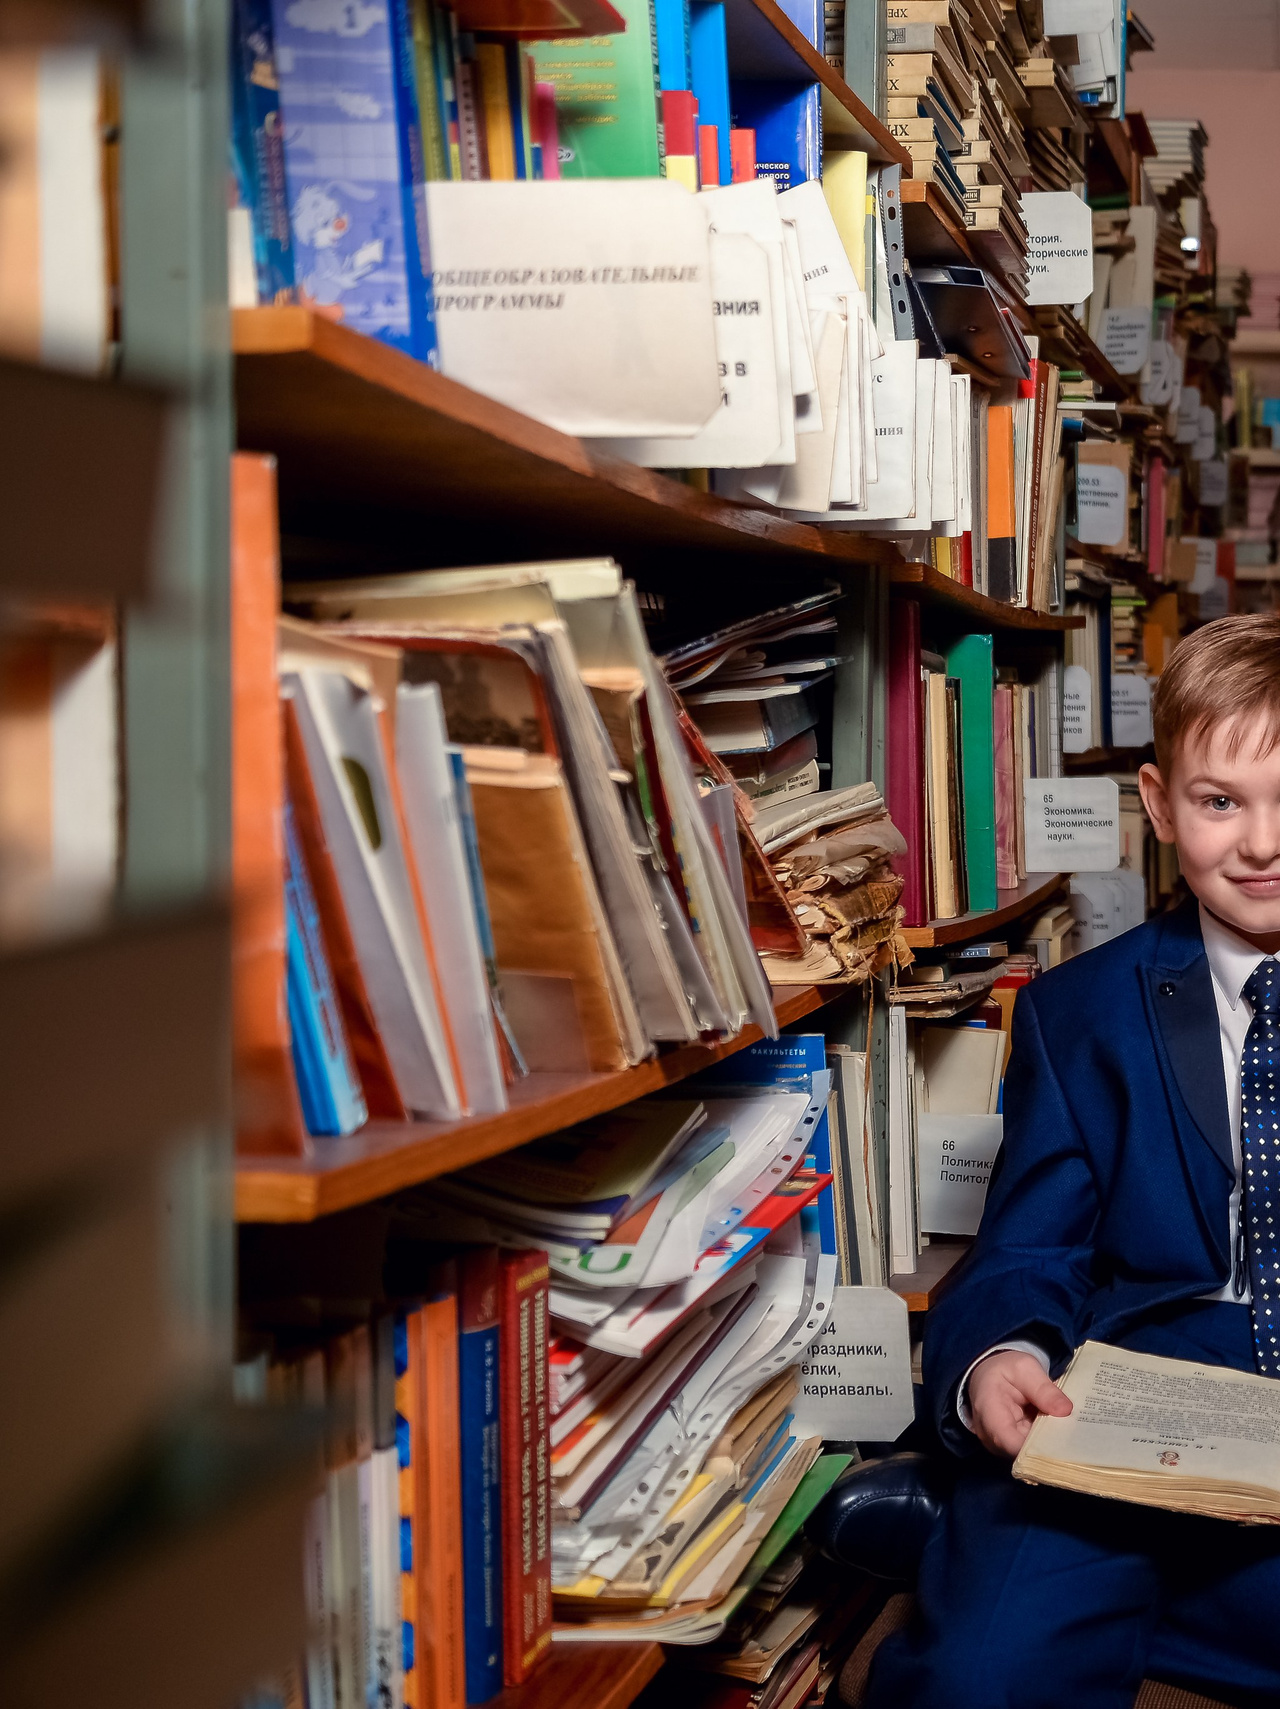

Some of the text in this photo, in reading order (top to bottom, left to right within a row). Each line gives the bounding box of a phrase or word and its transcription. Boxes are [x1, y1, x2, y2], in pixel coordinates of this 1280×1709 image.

[1043, 794, 1054, 804] 65
[1043, 806, 1095, 816] Экономика.
[1044, 819, 1114, 829] Экономические
[1047, 832, 1075, 843] науки.
[750, 1048, 806, 1056] ФАКУЛЬТЕТЫ
[942, 1139, 955, 1151] 66
[801, 1361, 841, 1378] ёлки,
[803, 1384, 894, 1399] карнавалы.
